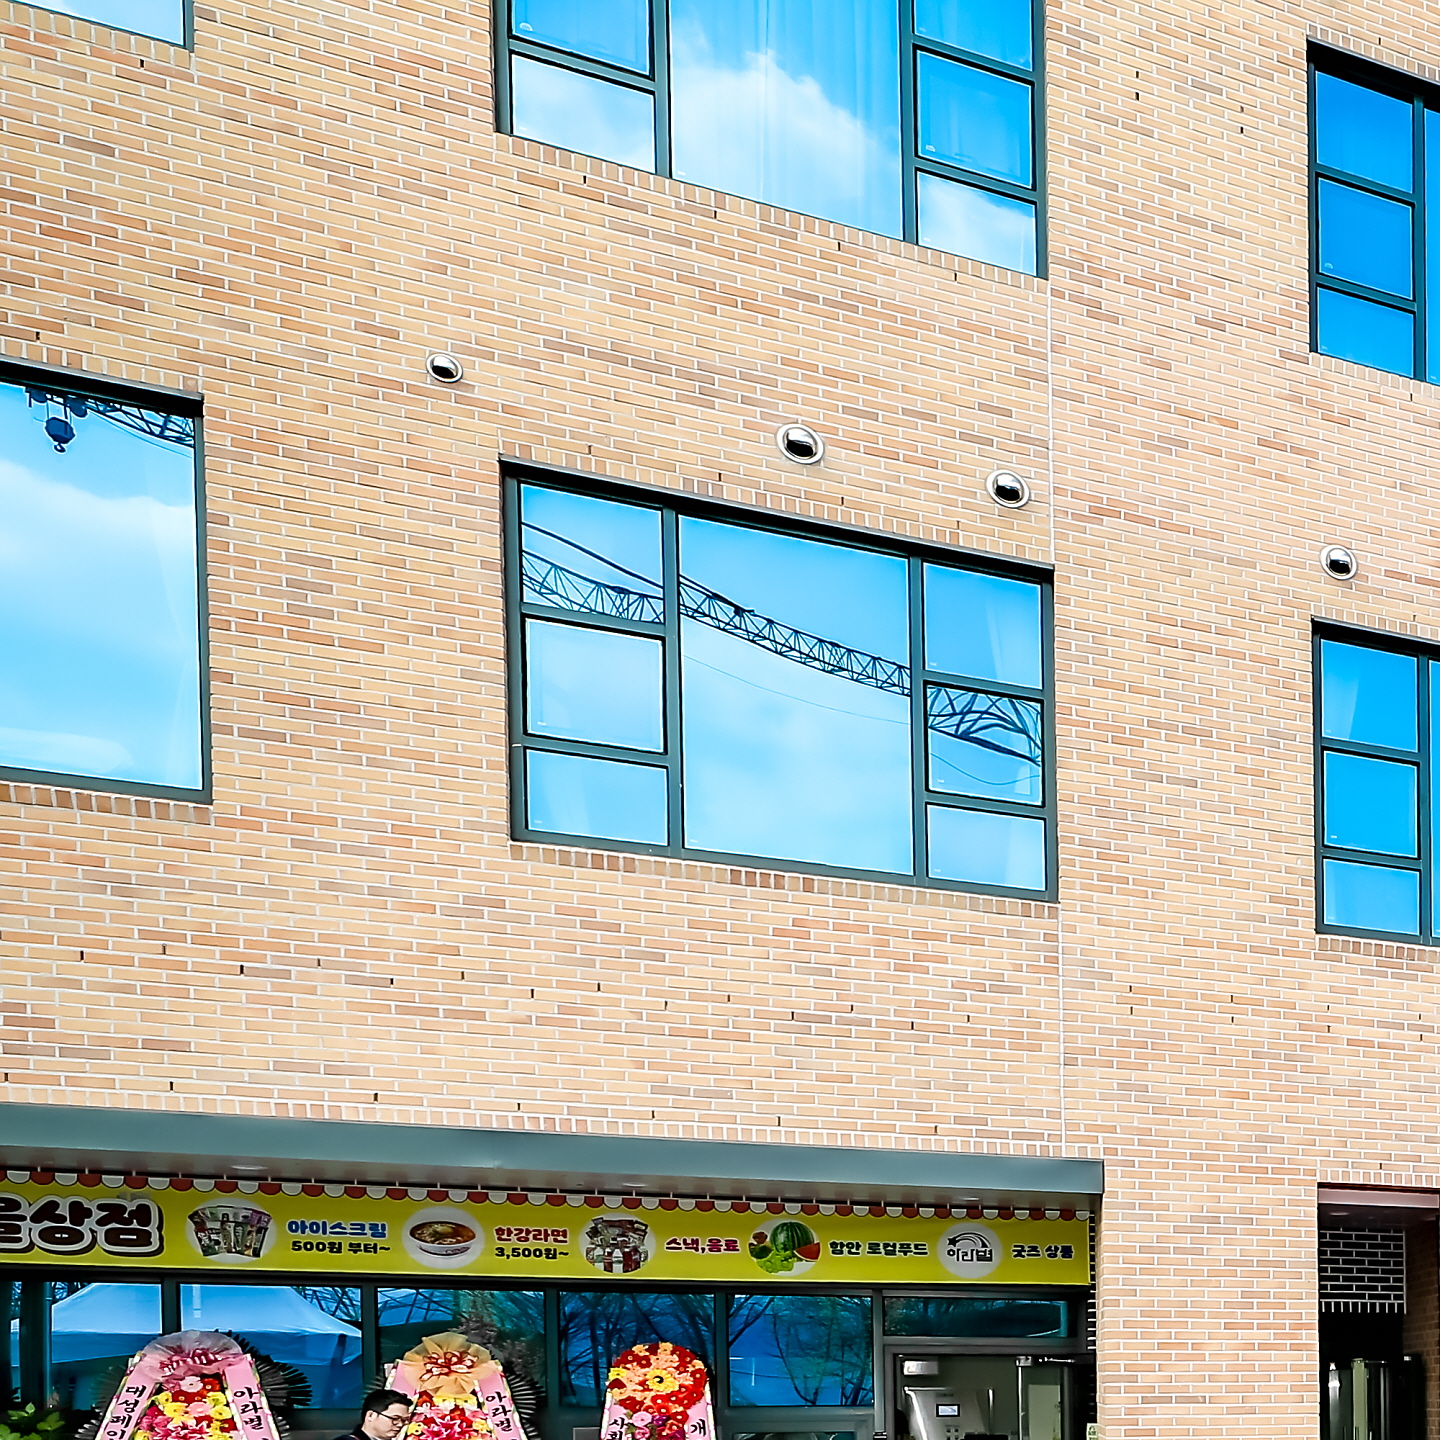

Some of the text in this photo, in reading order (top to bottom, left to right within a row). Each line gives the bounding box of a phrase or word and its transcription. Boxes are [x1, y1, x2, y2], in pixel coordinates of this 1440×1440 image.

[287, 1220, 387, 1239] 아이스크림
[494, 1227, 569, 1244] 한강라면
[291, 1241, 343, 1255] 500원
[829, 1241, 929, 1257] 함안 로컬푸드
[1045, 1244, 1074, 1259] 상품
[233, 1386, 263, 1430] 아라별
[485, 1391, 513, 1432] 아라별
